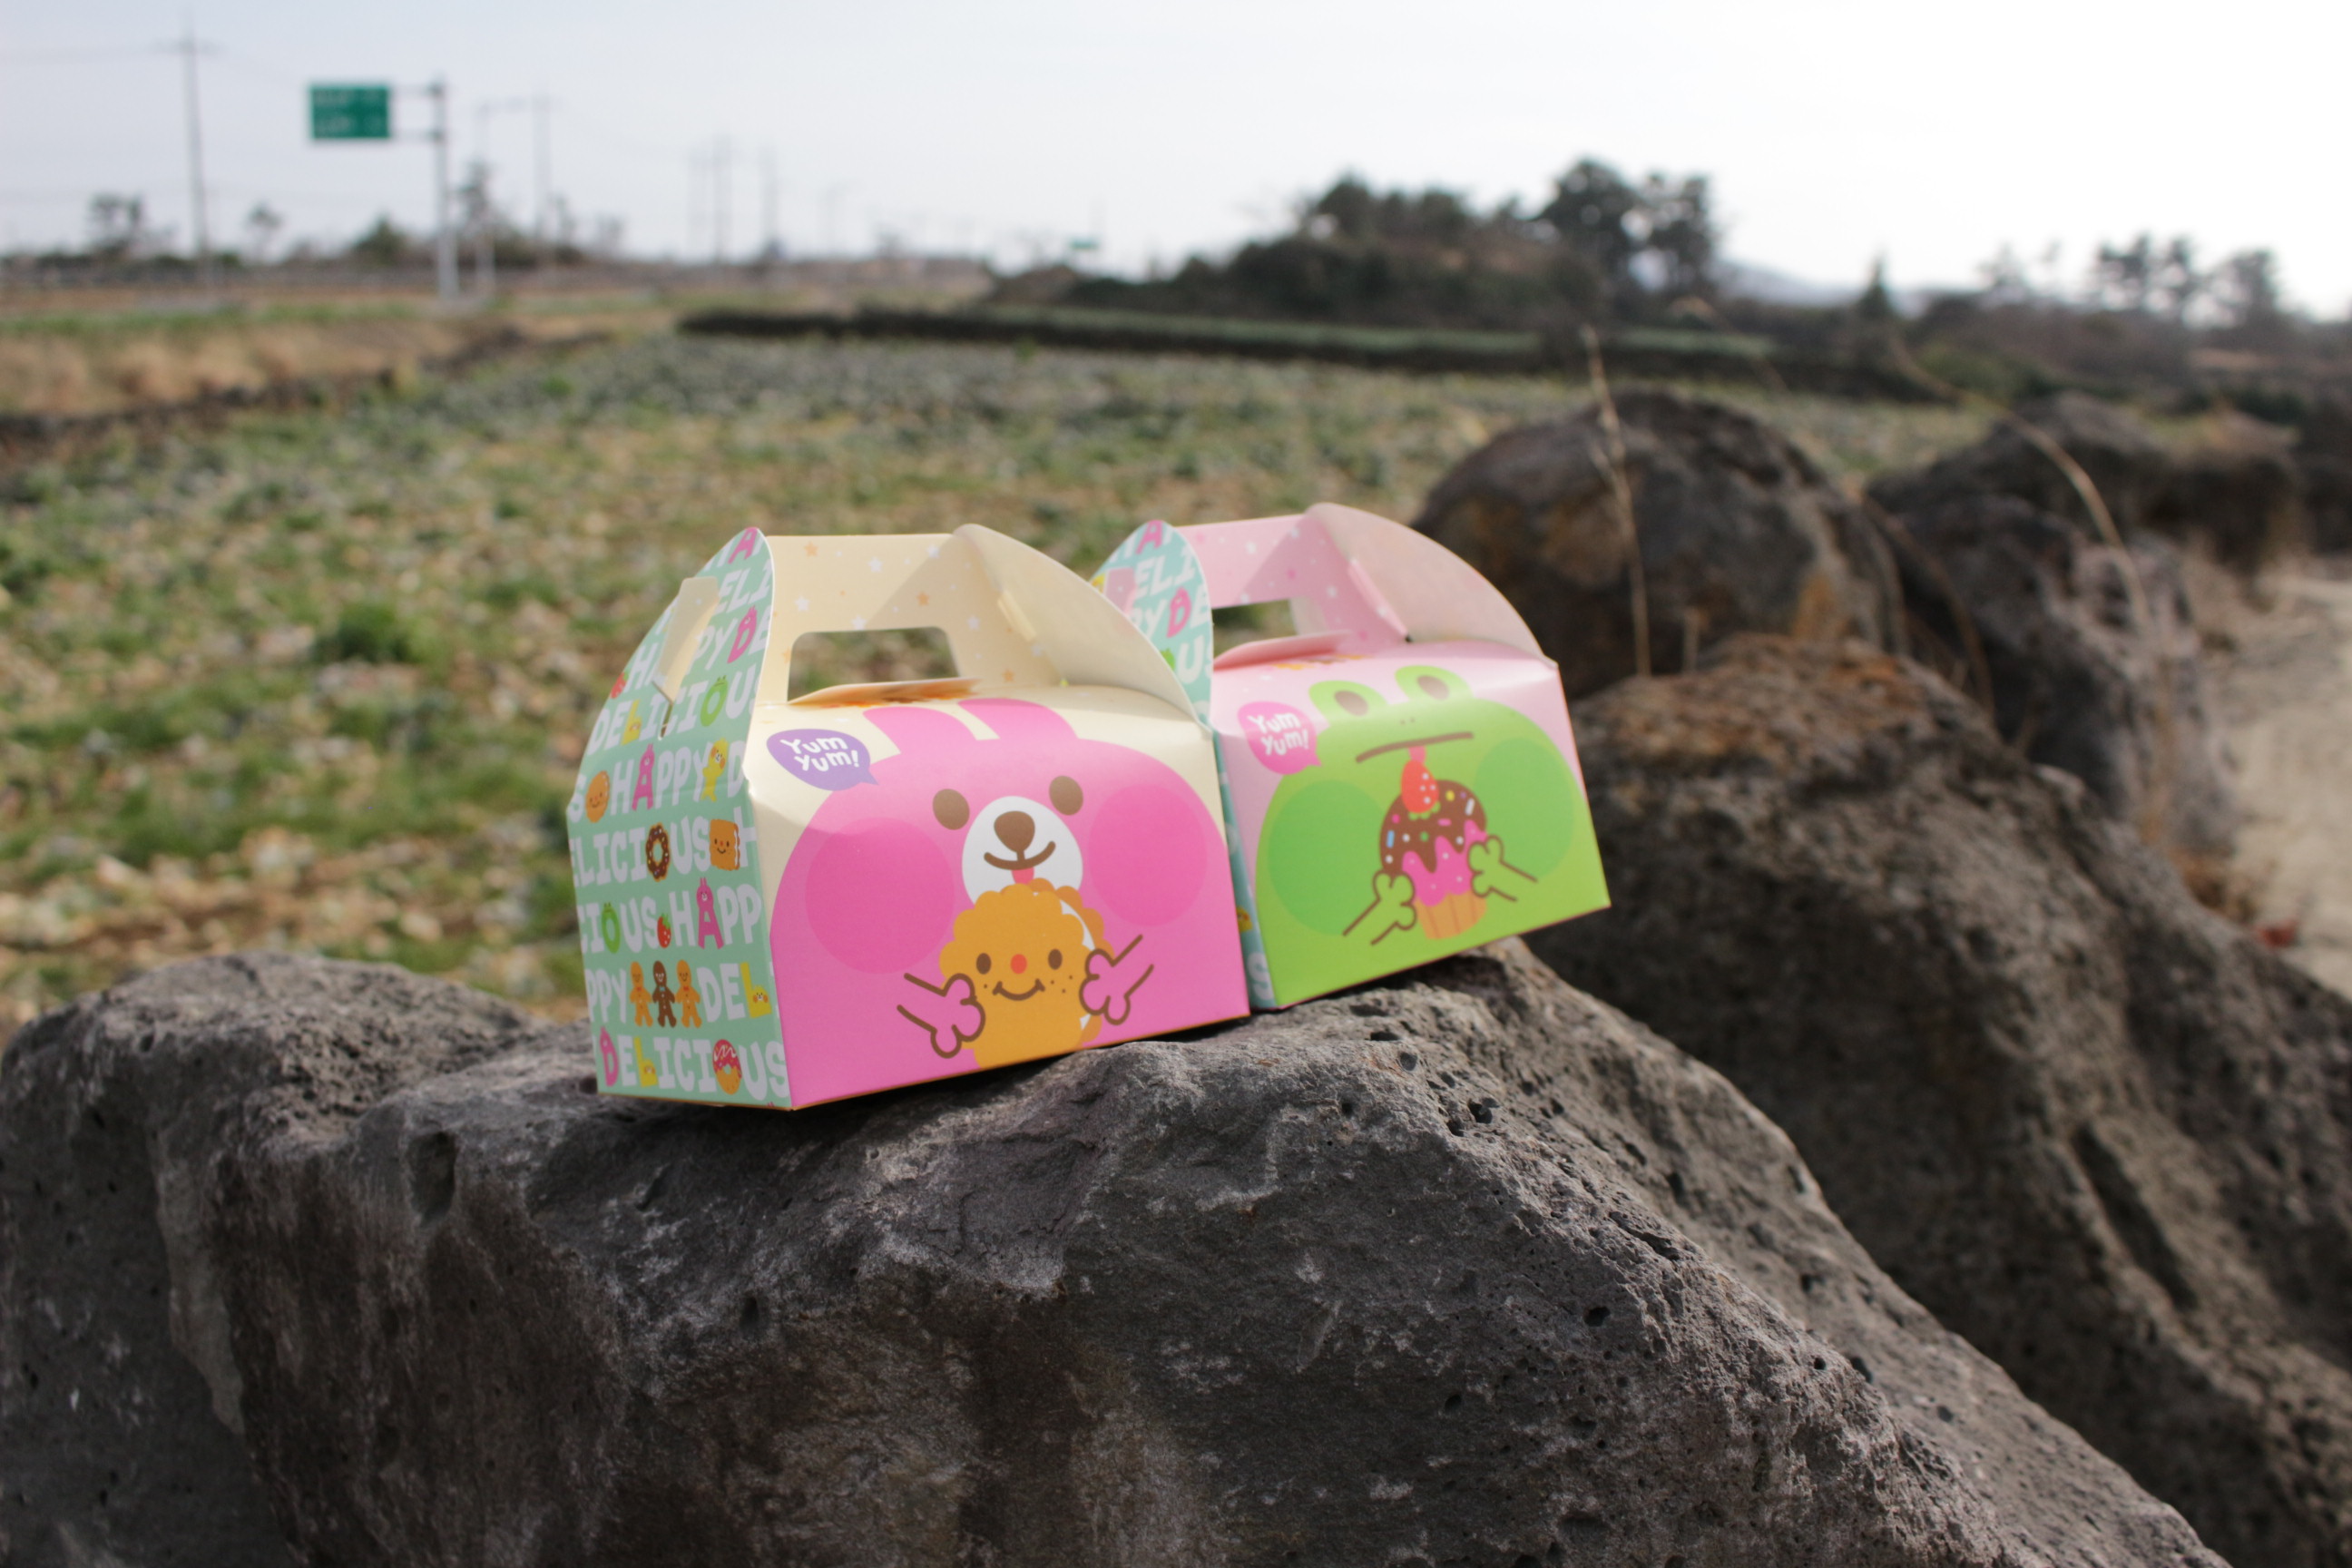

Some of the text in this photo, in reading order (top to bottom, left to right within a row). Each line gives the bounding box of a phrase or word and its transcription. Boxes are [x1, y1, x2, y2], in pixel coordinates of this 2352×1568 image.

[1247, 712, 1301, 734] Yum
[779, 736, 848, 755] Yum
[1260, 729, 1309, 755] Yum!
[794, 750, 859, 772] Yum!
[610, 739, 714, 815] HAPPY
[697, 961, 779, 1023] DEL
[599, 1025, 790, 1101] DELICIOUS
